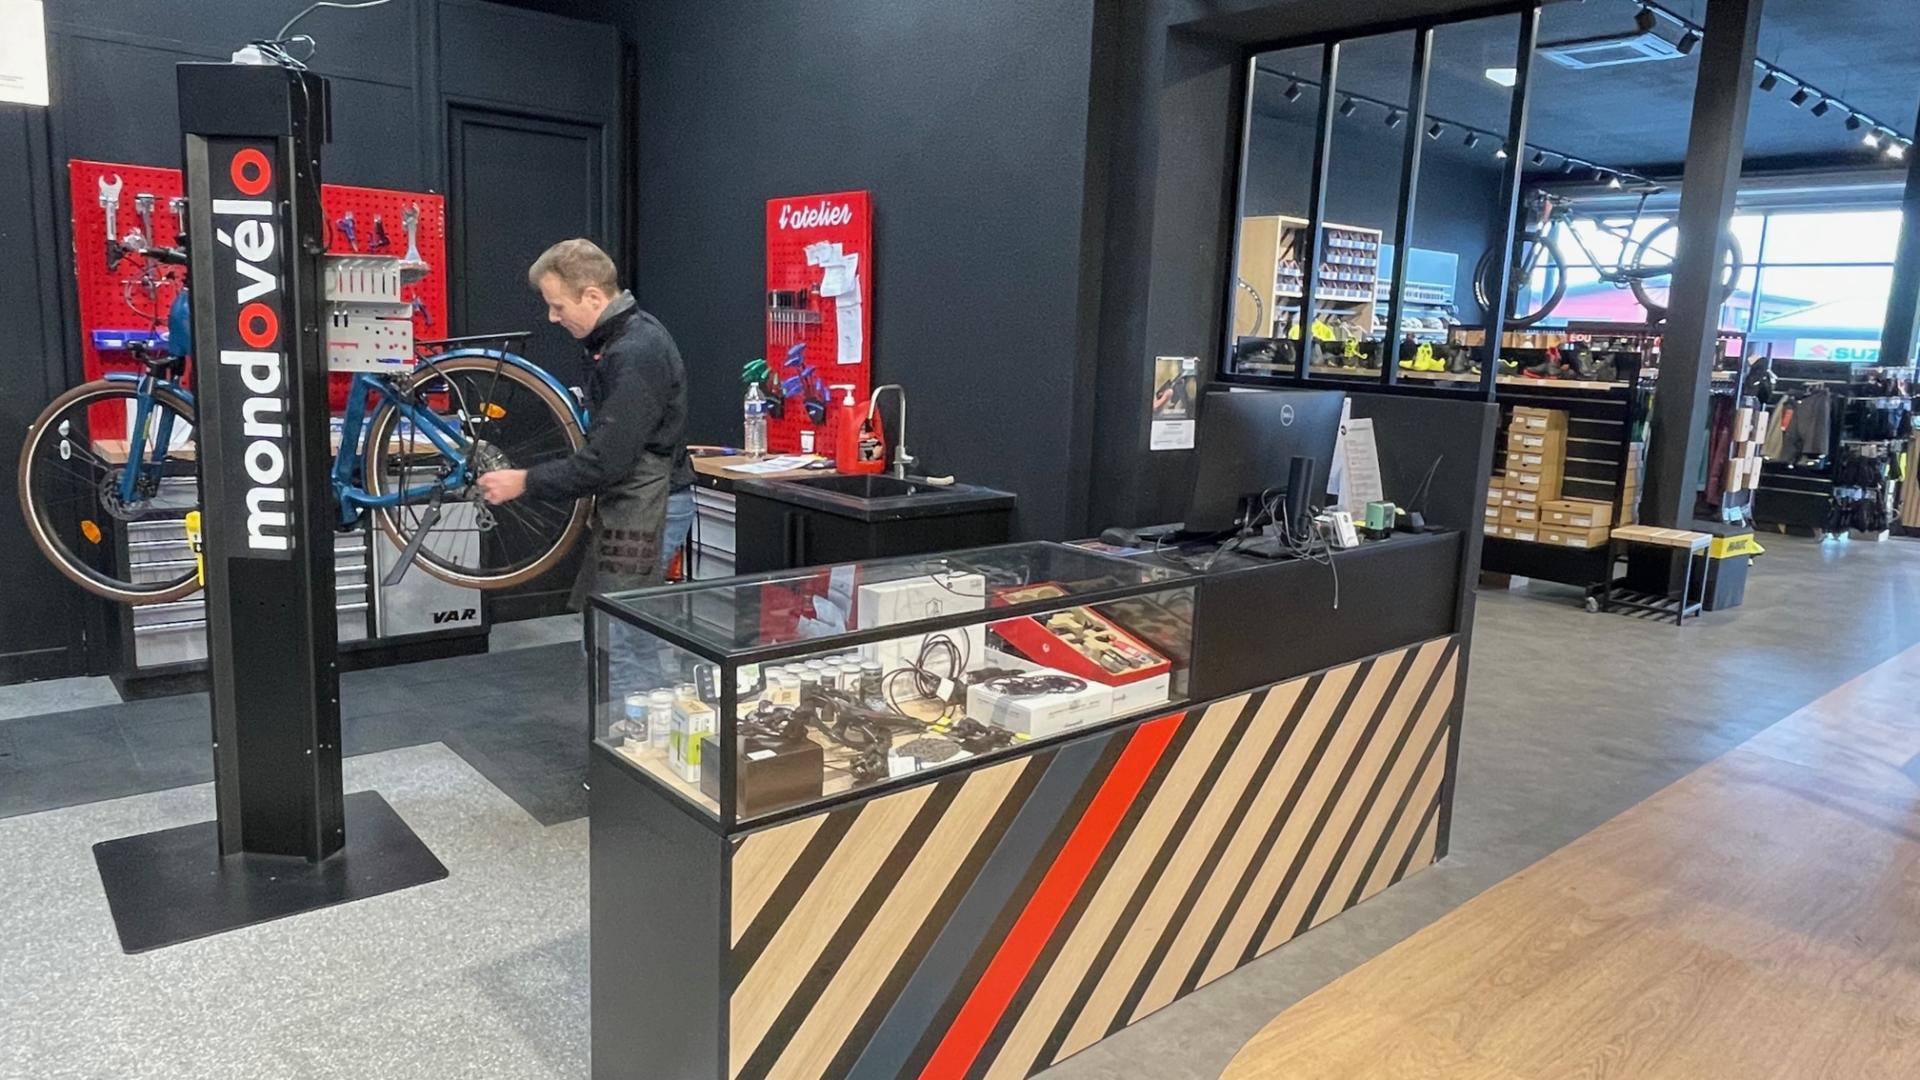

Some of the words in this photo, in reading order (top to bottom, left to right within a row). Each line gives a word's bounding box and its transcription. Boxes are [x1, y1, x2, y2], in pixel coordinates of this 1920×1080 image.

[779, 200, 853, 230] l'atelier
[212, 148, 287, 550] mondovélo
[433, 608, 476, 624] VAR
